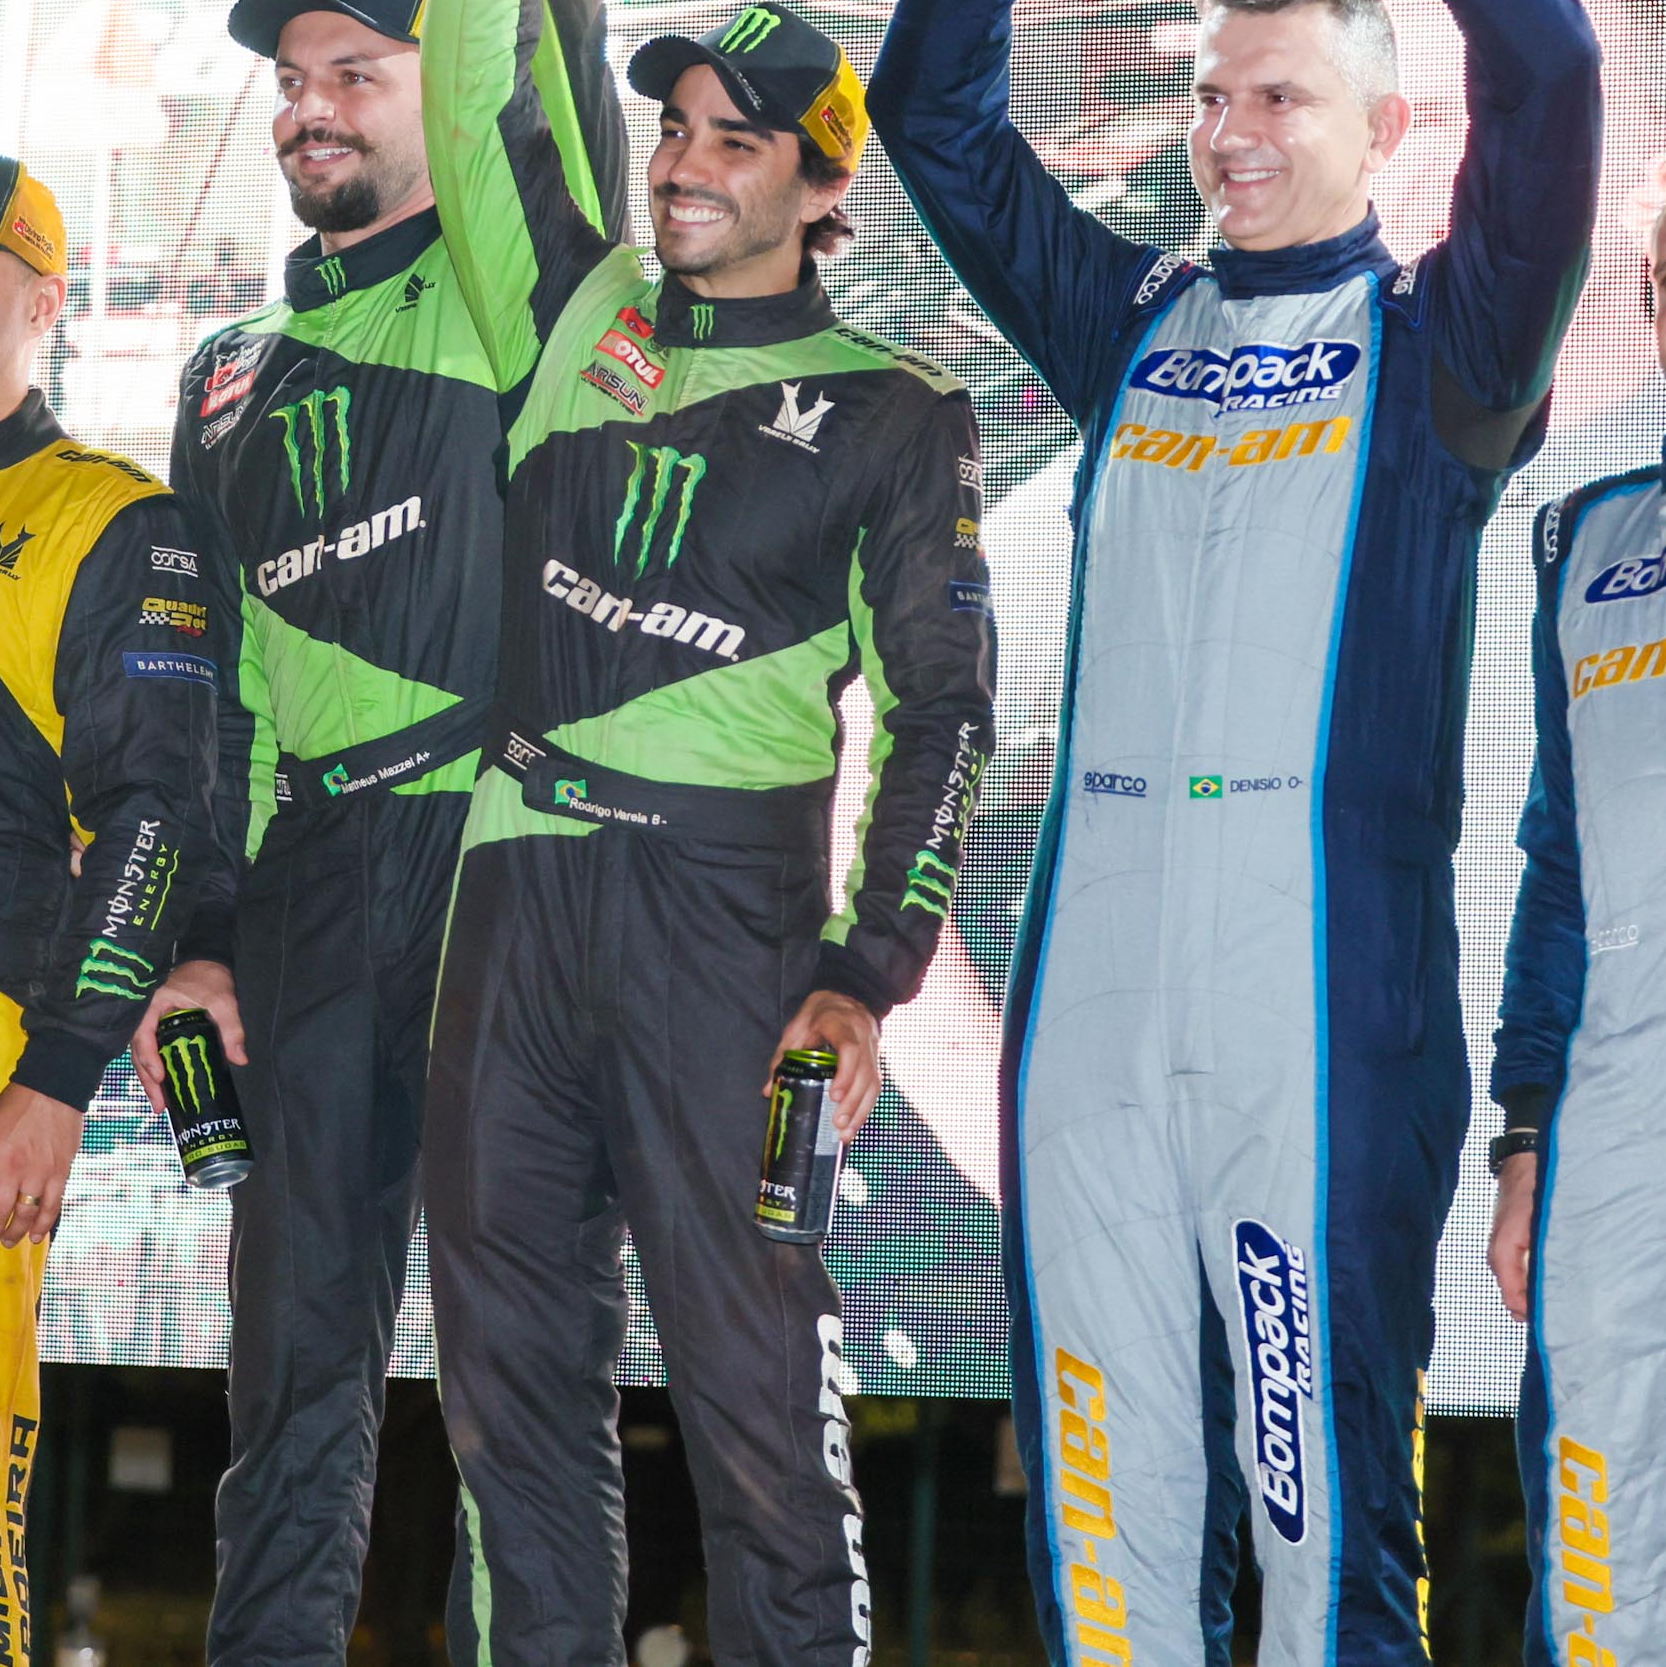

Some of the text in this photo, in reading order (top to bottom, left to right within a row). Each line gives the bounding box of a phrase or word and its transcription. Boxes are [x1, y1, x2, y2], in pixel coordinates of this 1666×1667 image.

[603, 334, 660, 385] OTUL
[1220, 386, 1344, 412] RACING
[1111, 415, 1353, 472] can-am
[255, 495, 428, 599] can-am
[541, 558, 746, 662] can-am
[137, 660, 214, 681] BARTHELEM
[569, 797, 612, 819] Rodrigo
[1084, 771, 1147, 793] sparco
[1229, 776, 1282, 793] DENISIO
[101, 819, 161, 938] MONSTER
[132, 843, 168, 926] ENERGY
[184, 1133, 235, 1152] NERGY
[1281, 1244, 1312, 1399] RACING
[1237, 1242, 1299, 1516] Bompack
